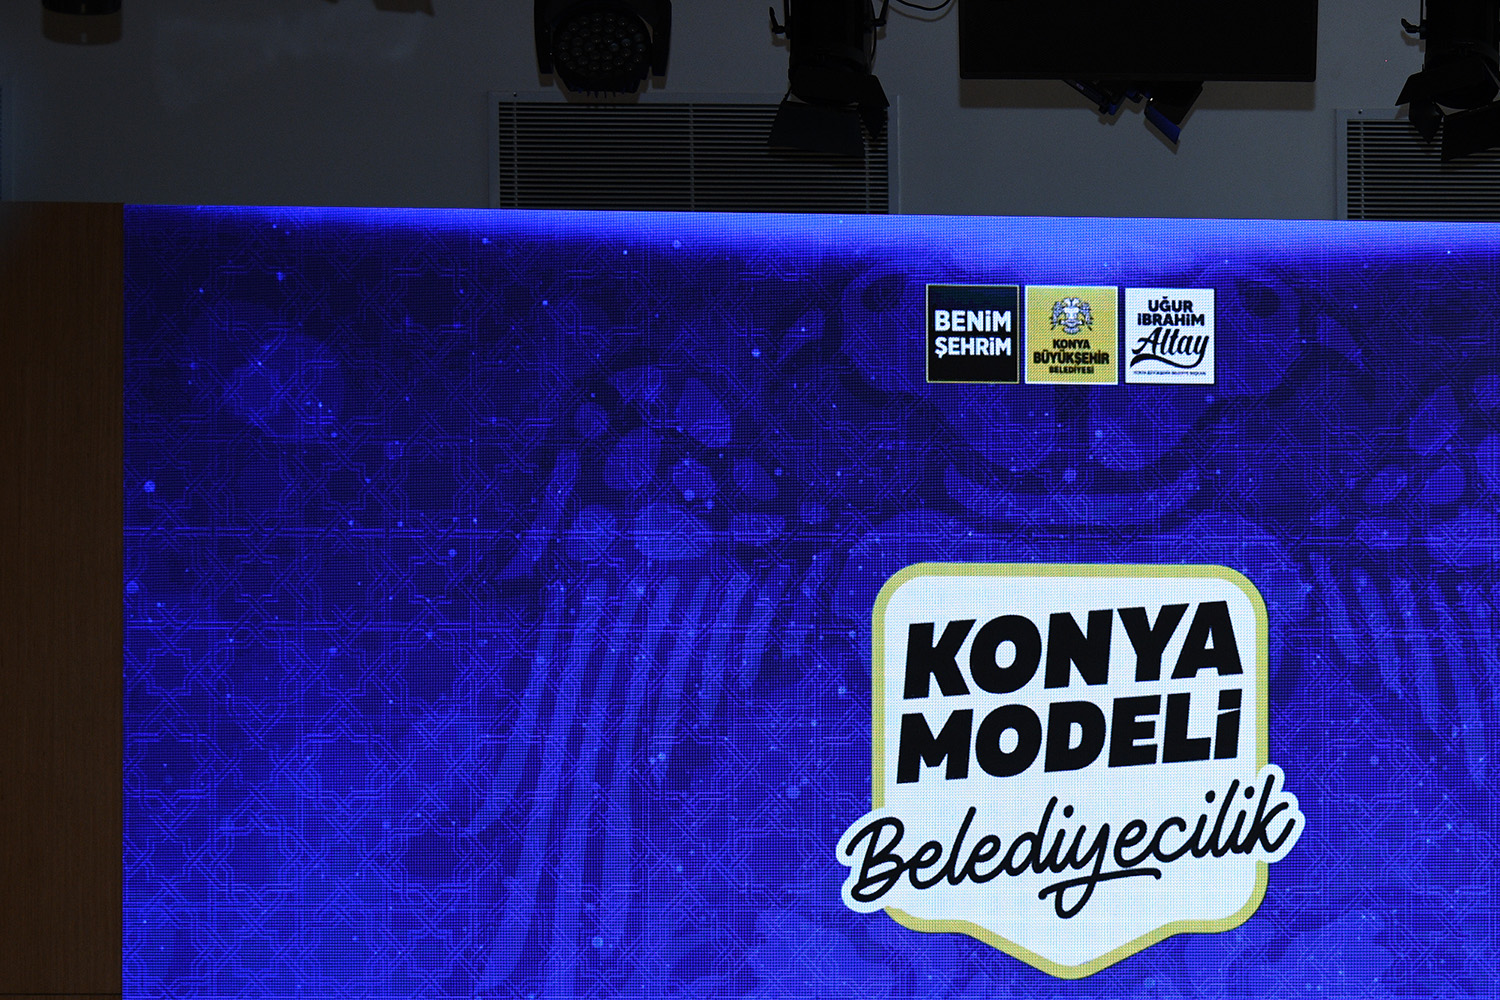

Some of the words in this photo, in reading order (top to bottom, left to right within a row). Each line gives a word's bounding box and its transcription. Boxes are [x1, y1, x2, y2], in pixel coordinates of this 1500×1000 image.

[1148, 296, 1194, 313] UĞUR
[1033, 349, 1110, 365] BÜYÜKŞEHİR
[1052, 339, 1091, 349] KONYA
[1130, 327, 1210, 369] Altay
[903, 600, 1244, 700] KONYA
[896, 688, 1243, 784] MODELİ
[846, 774, 1296, 919] Belediyecilik
